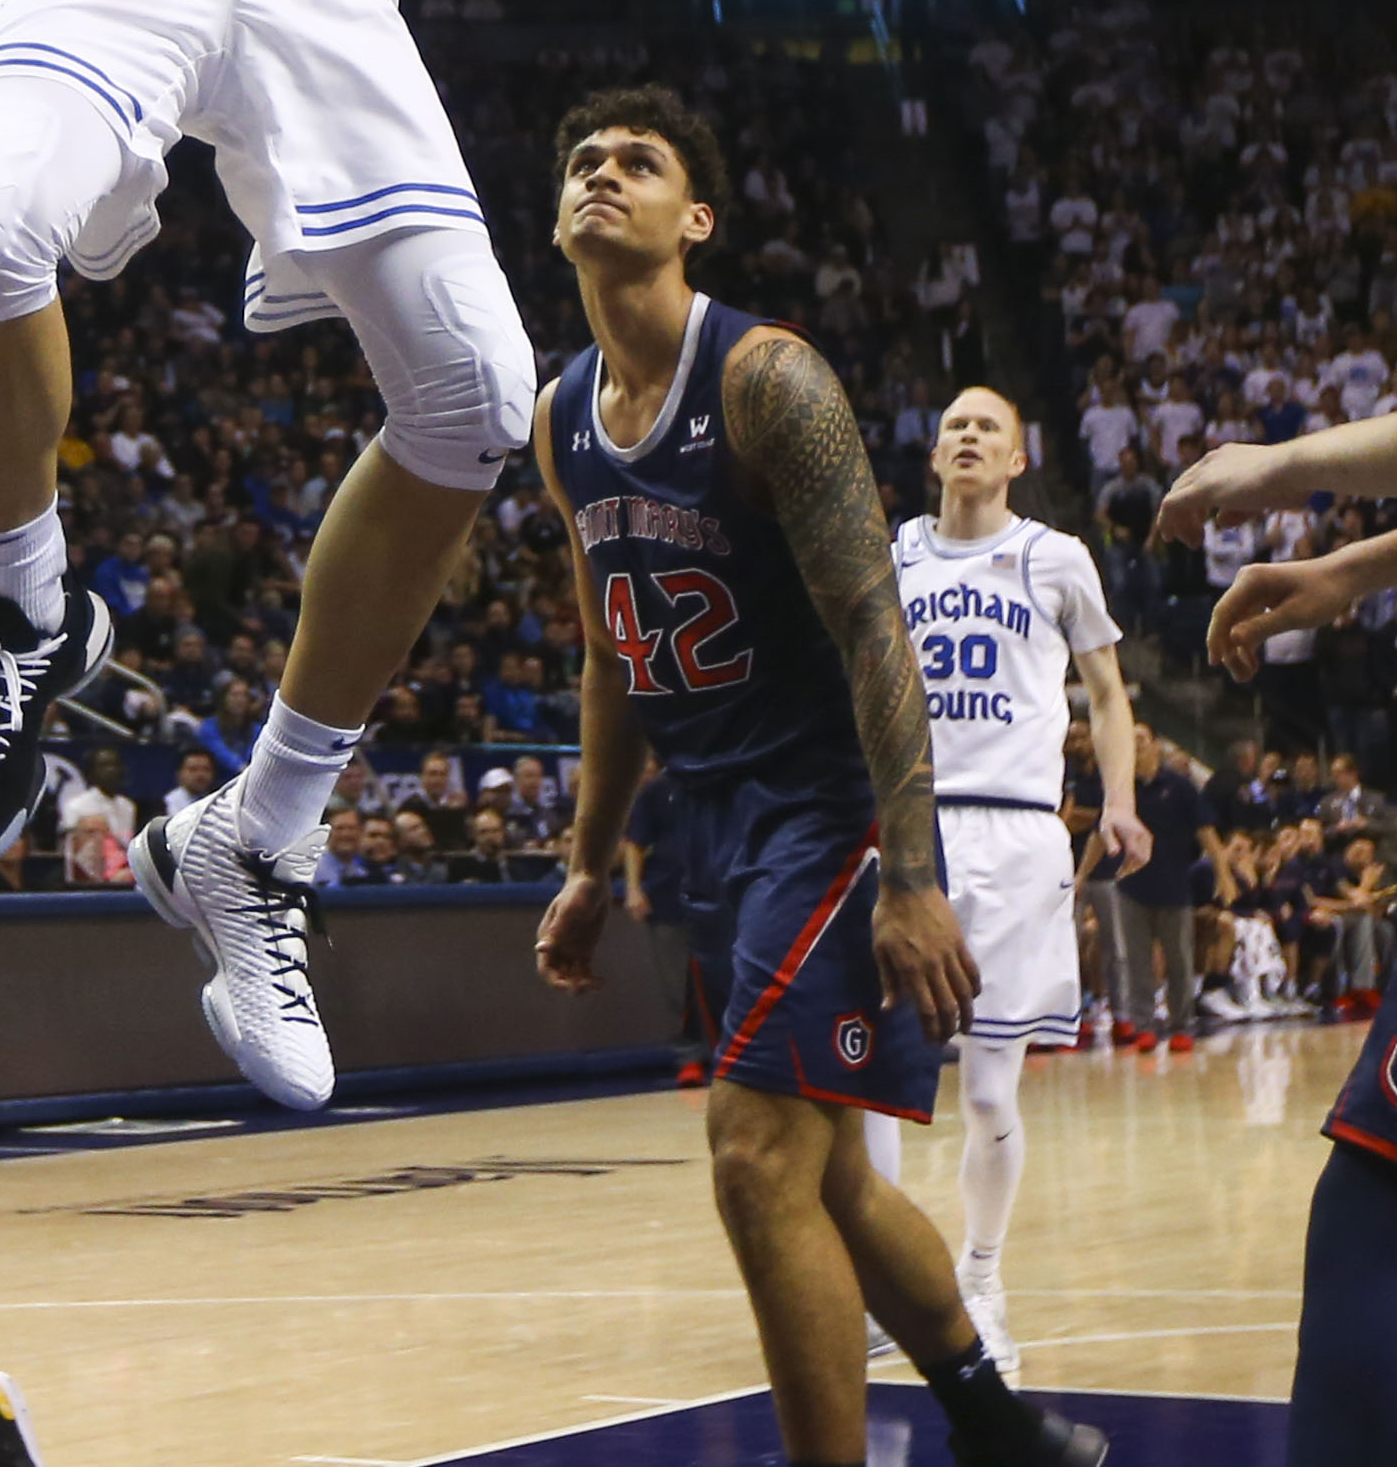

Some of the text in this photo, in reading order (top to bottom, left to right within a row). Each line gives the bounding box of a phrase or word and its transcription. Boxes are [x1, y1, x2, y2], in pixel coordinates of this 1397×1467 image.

[605, 568, 753, 695] 42
[922, 634, 998, 680] 30
[845, 1027, 862, 1056] G
